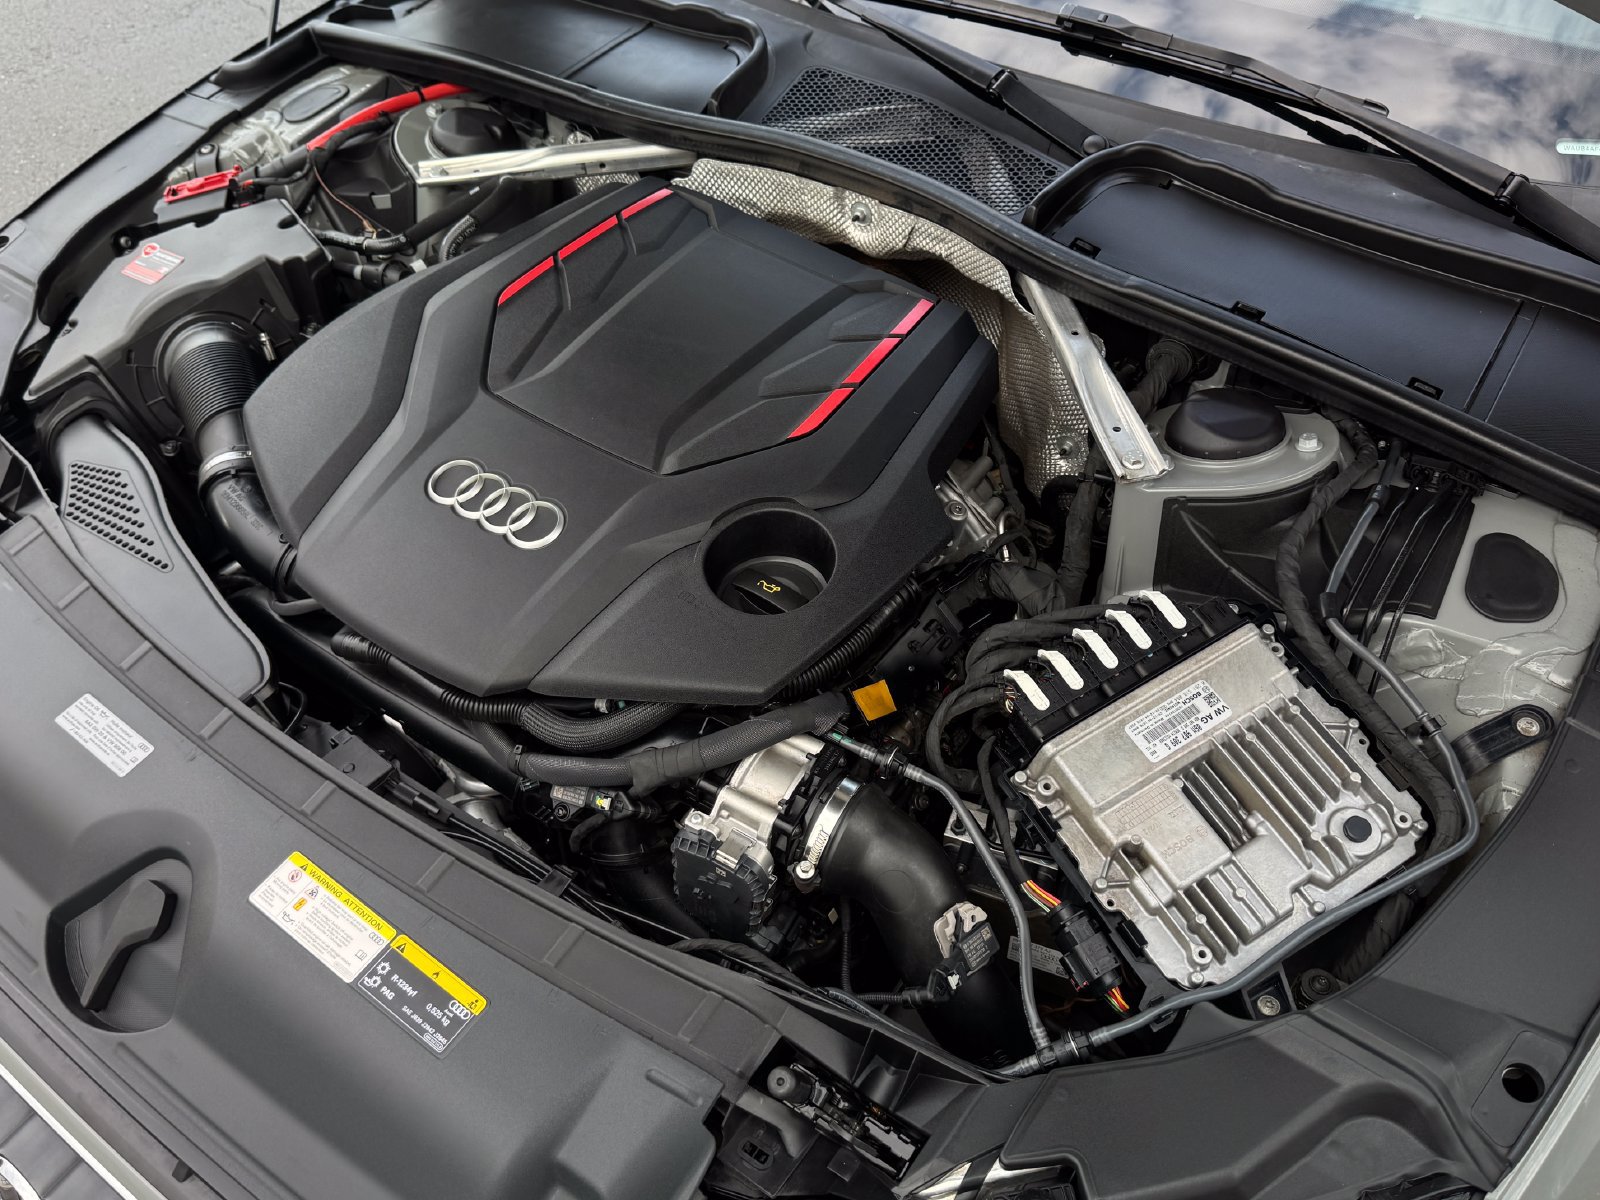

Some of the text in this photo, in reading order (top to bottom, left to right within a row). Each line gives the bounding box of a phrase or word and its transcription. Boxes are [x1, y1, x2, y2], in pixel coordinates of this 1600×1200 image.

[1181, 690, 1201, 706] BOSCH
[1199, 703, 1228, 724] VW AG
[1161, 833, 1194, 859] BOSCH
[308, 868, 343, 898] WARNING
[343, 897, 383, 930] ATTENTION
[379, 985, 395, 1000] PAG
[390, 973, 418, 998] R-1234yf
[401, 1004, 412, 1015] SAE
[424, 1002, 451, 1027] 0,525 kg
